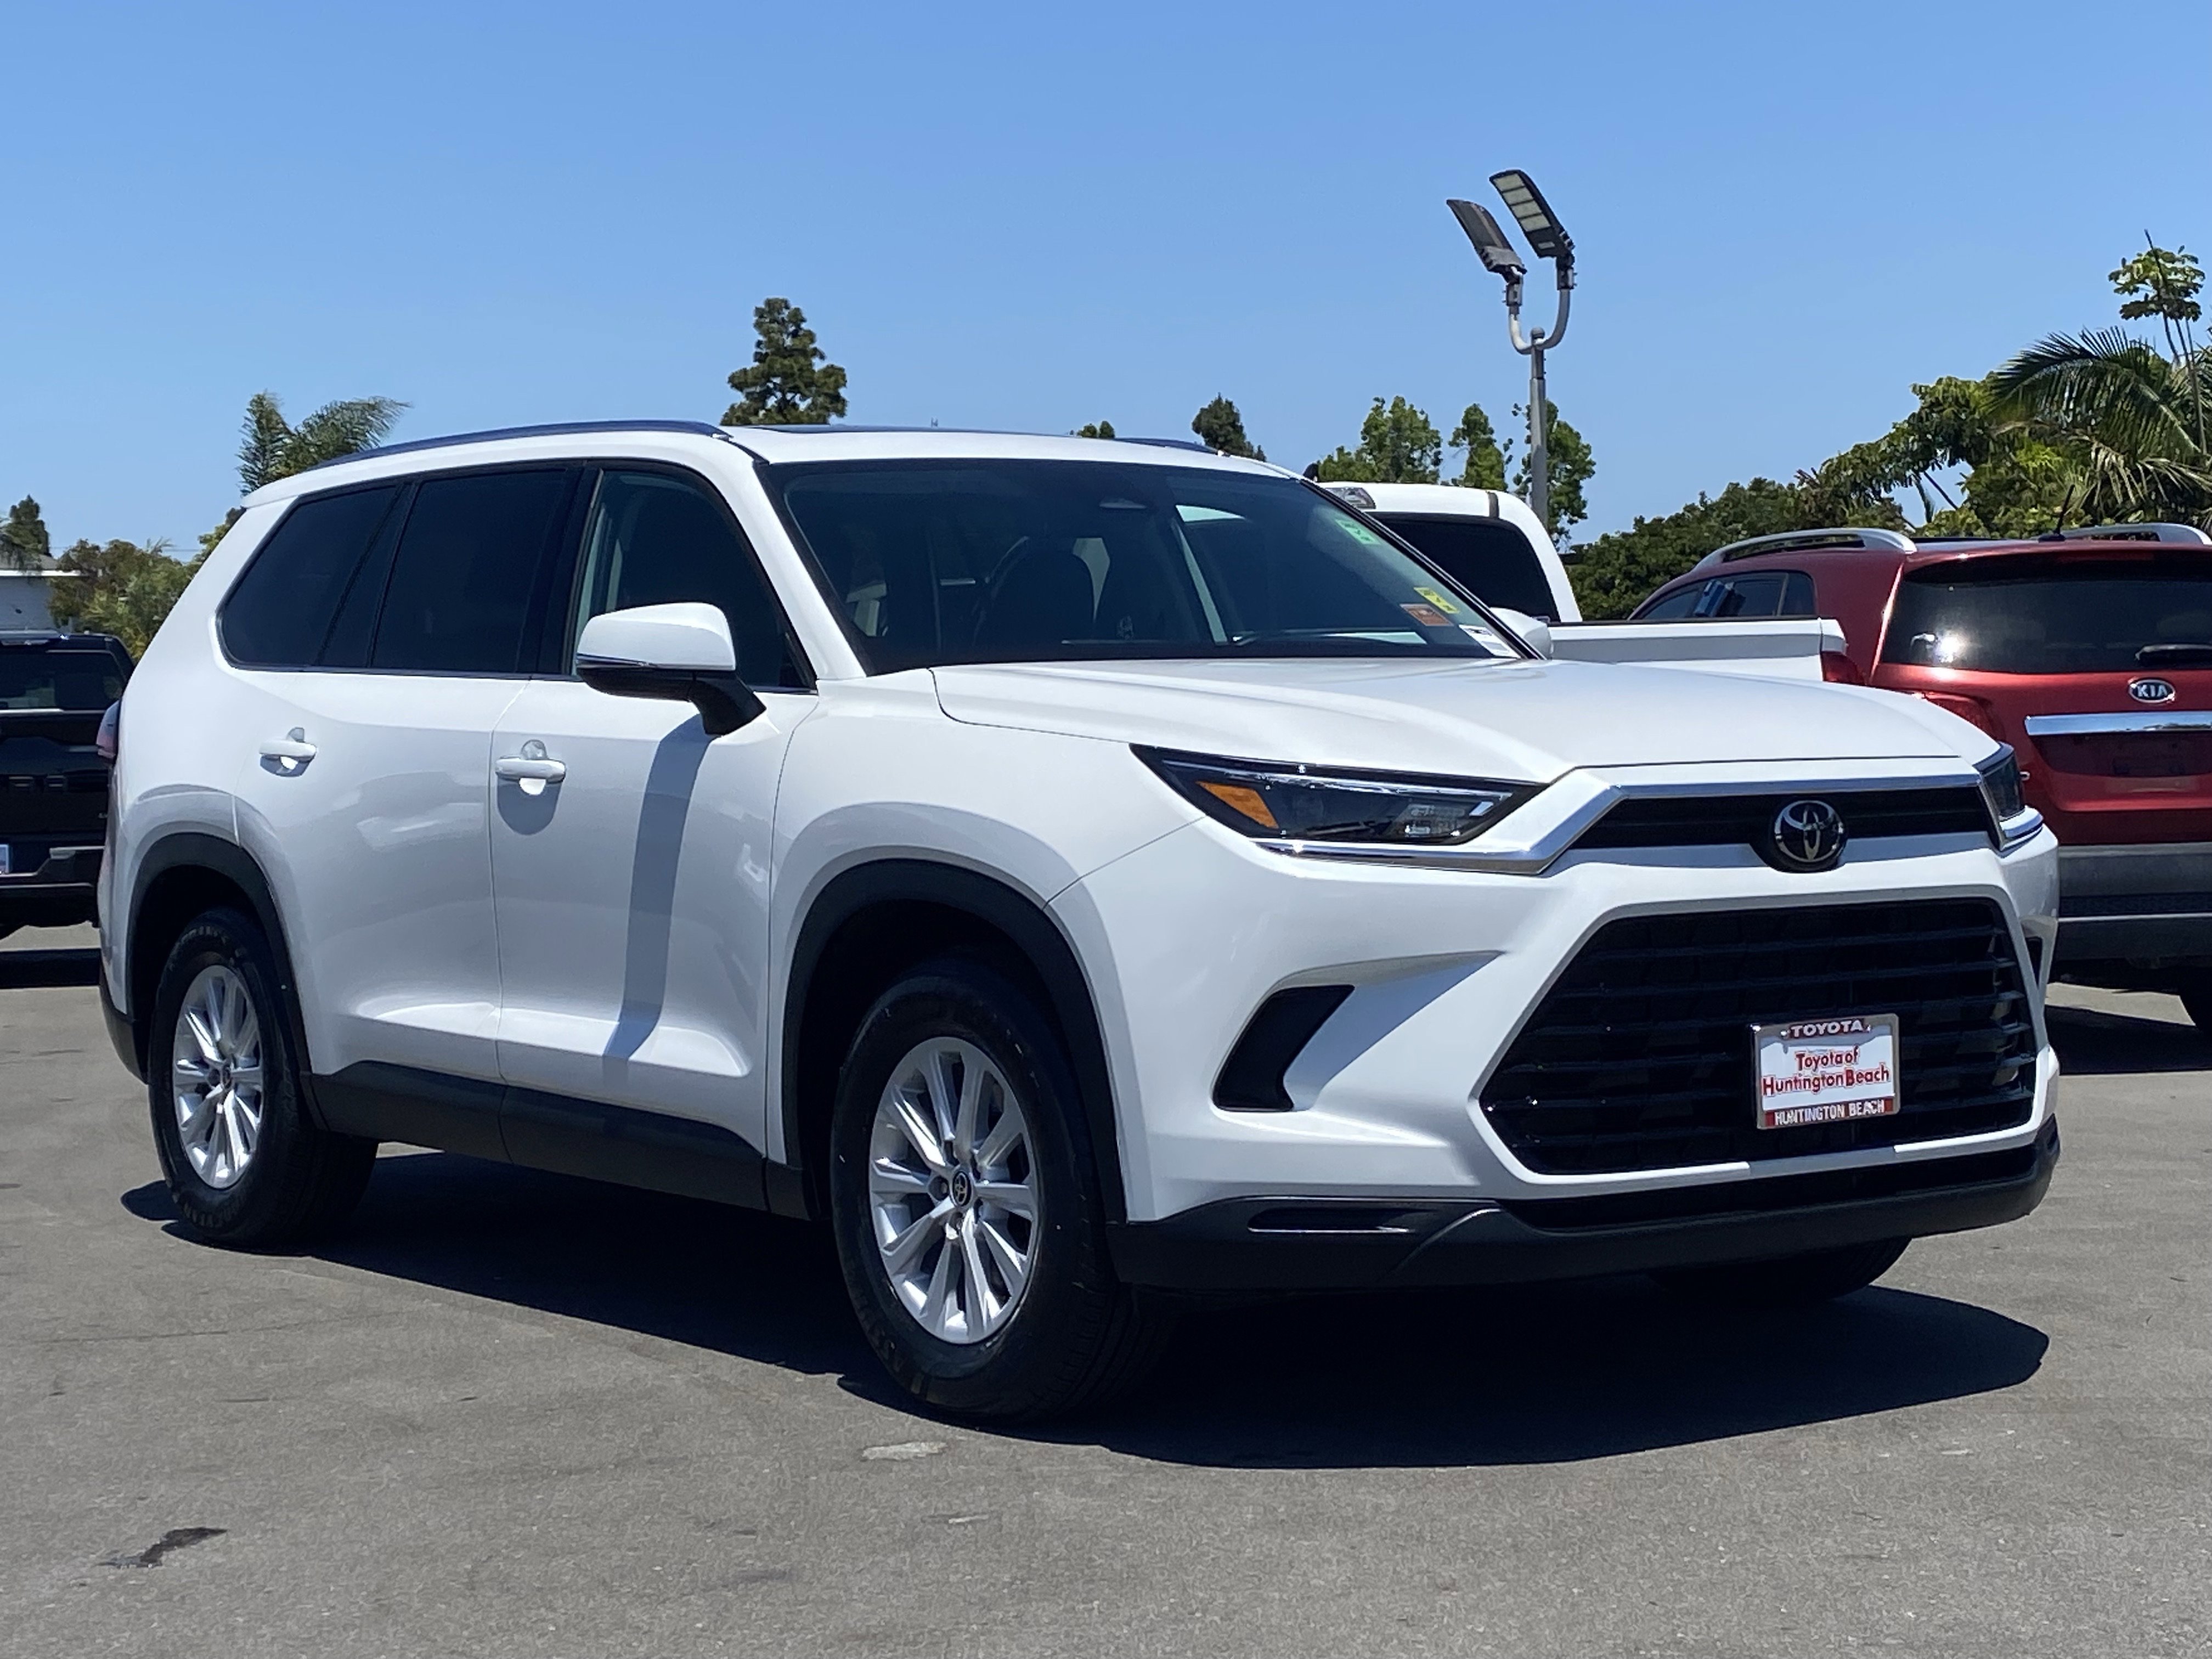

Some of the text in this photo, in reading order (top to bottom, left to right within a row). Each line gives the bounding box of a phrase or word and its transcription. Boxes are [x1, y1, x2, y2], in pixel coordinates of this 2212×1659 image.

[2137, 684, 2168, 697] KIA
[1791, 1020, 1864, 1038] TOYOTA
[1796, 1045, 1859, 1071] Toyota of
[1763, 1065, 1889, 1096] Huntington Beach
[1774, 1099, 1885, 1125] HUNTINGTON BEACH
